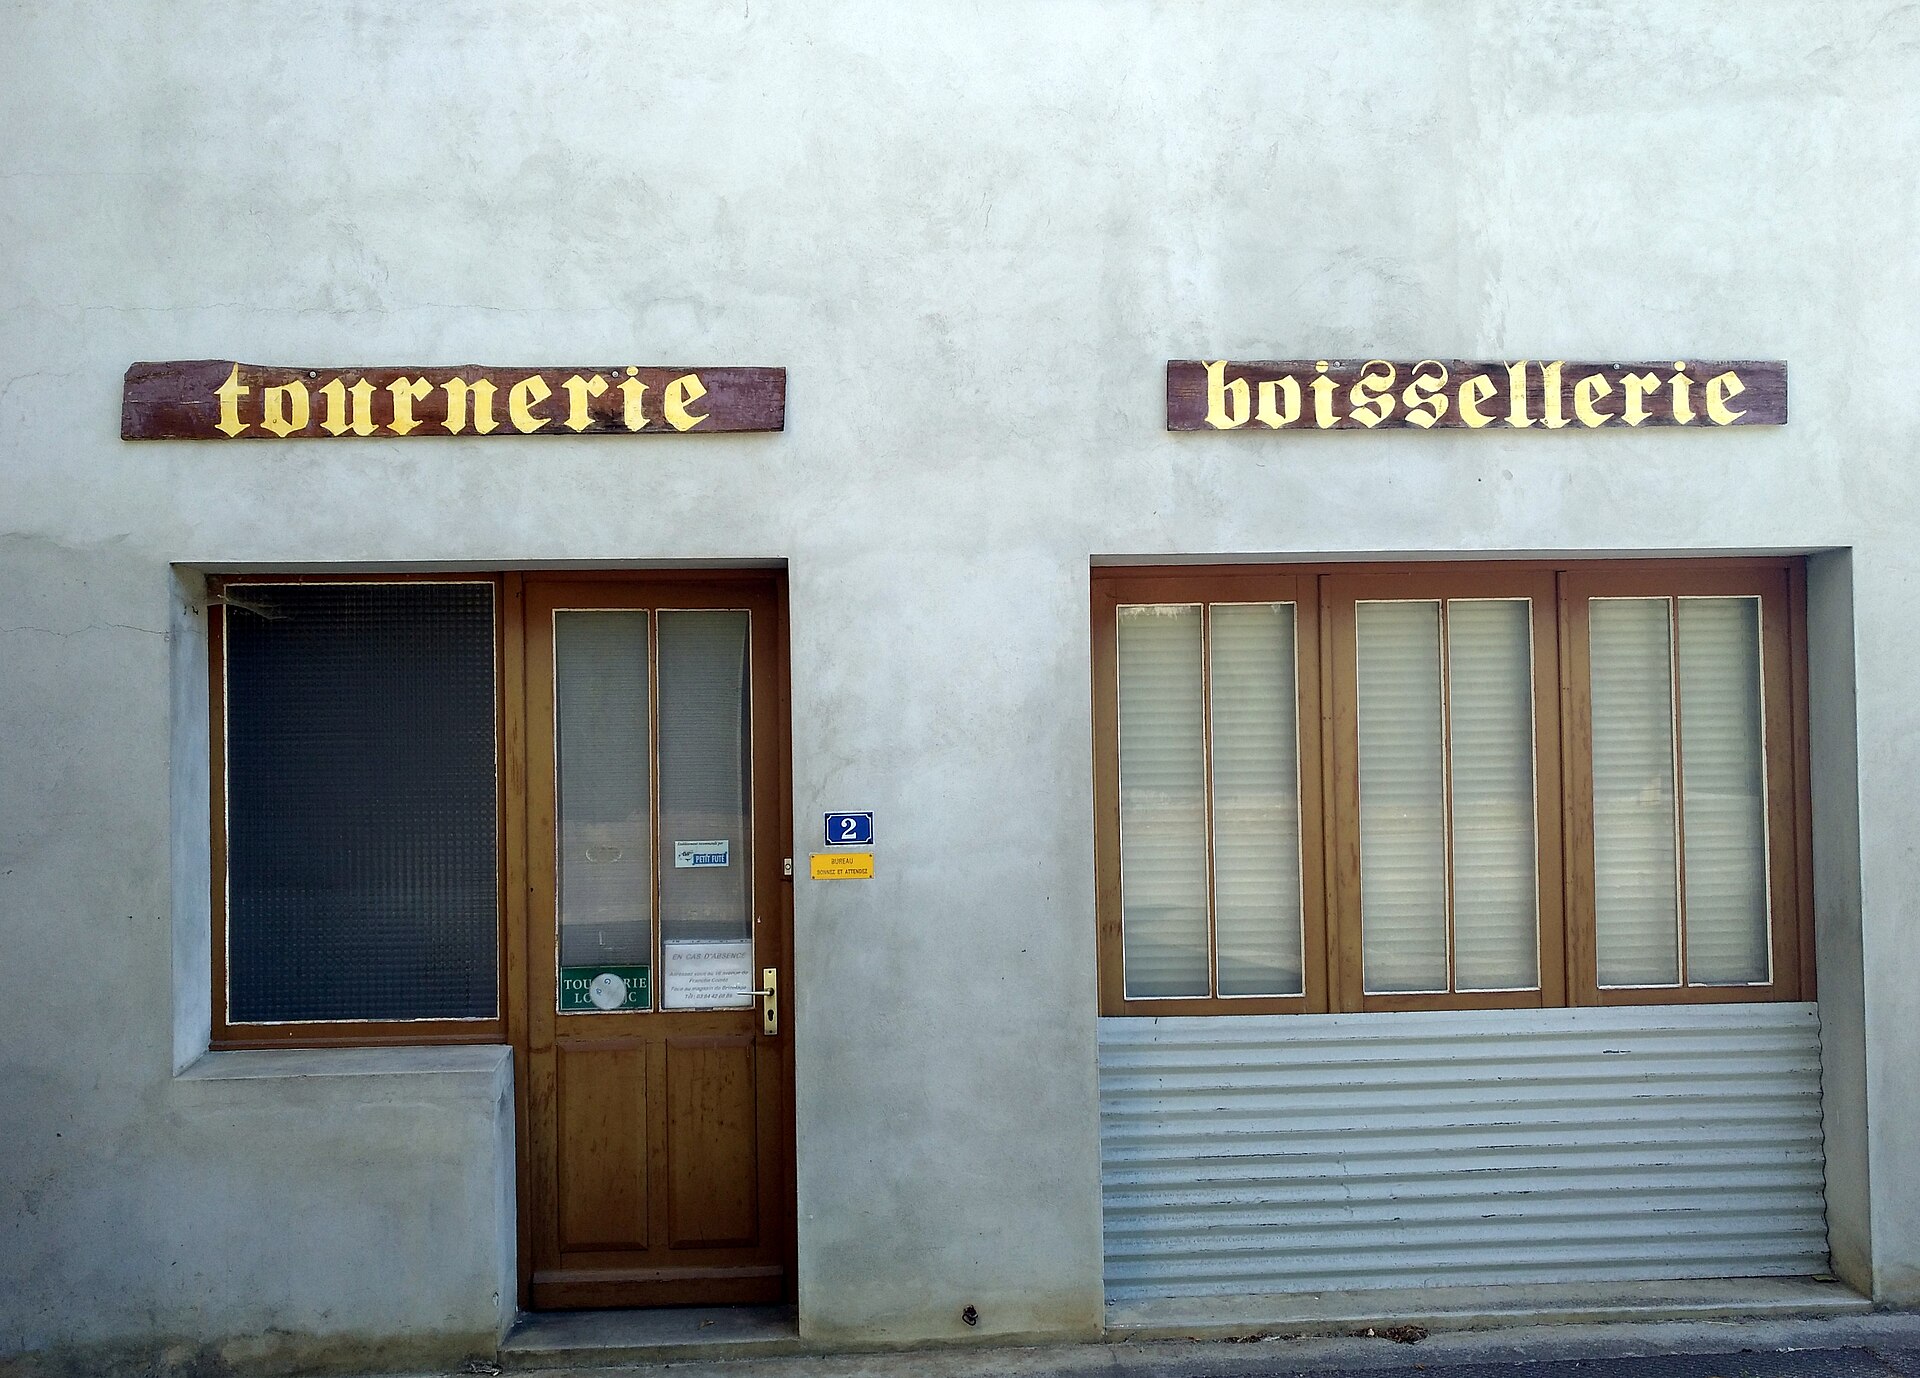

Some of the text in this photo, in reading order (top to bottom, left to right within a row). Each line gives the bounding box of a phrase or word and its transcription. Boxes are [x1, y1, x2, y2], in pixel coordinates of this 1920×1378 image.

[212, 362, 710, 437] tournerie
[1202, 359, 1747, 430] boissellerie
[841, 818, 857, 839] 2
[695, 855, 710, 863] PETIT
[704, 952, 746, 960] D'ABSENCE
[564, 978, 646, 990] TOURIE
